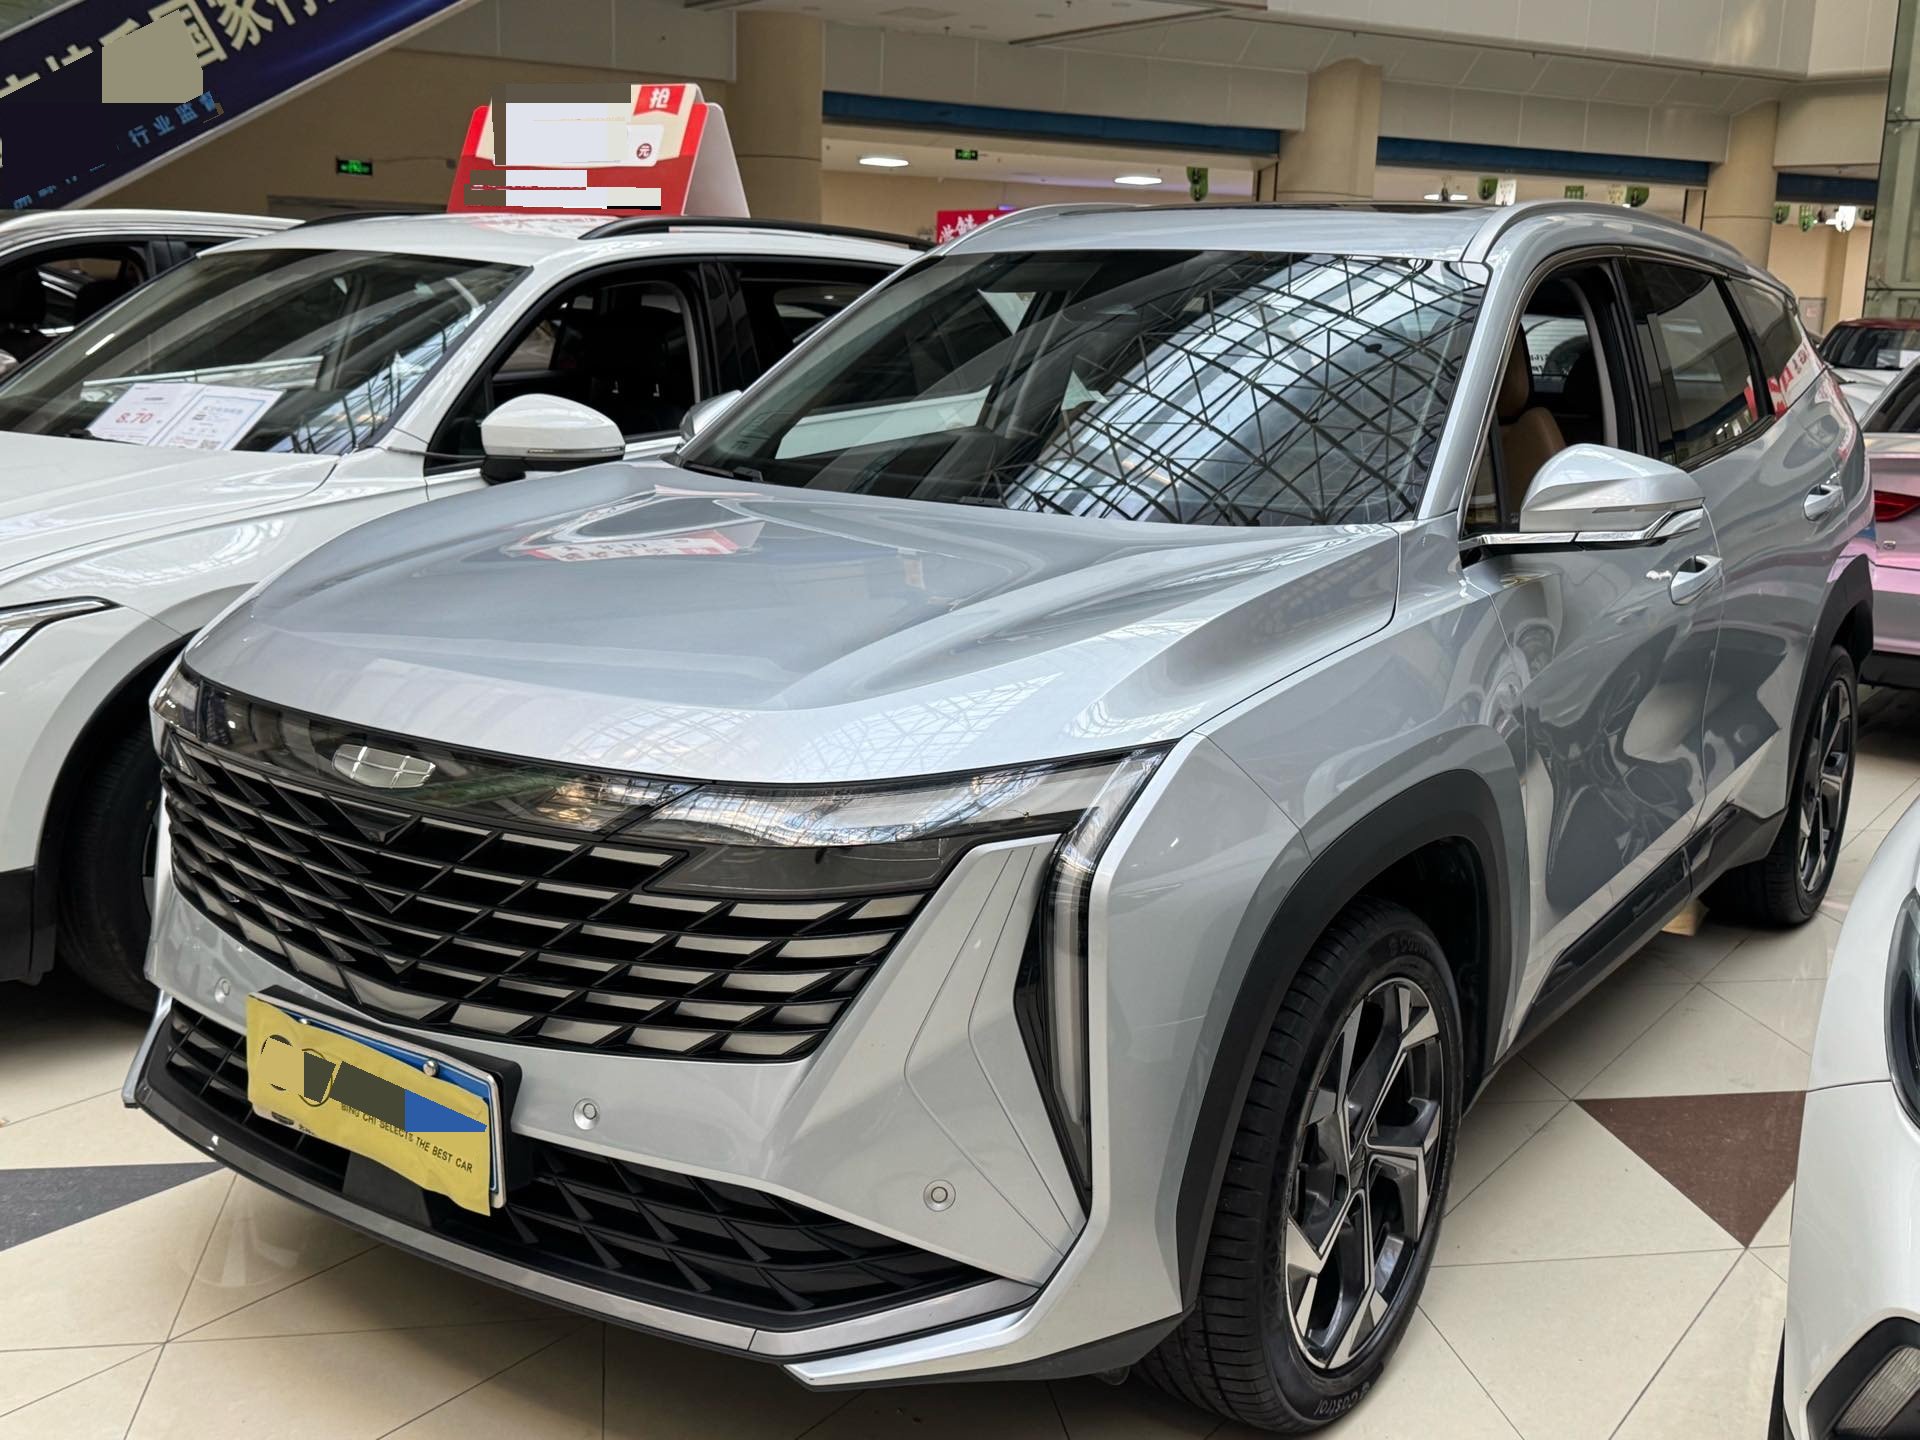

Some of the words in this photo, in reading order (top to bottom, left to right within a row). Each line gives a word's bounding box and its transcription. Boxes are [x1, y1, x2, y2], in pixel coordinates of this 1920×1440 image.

[416, 1136, 431, 1152] THE
[432, 1146, 453, 1163] BEST
[455, 1157, 474, 1174] CAR
